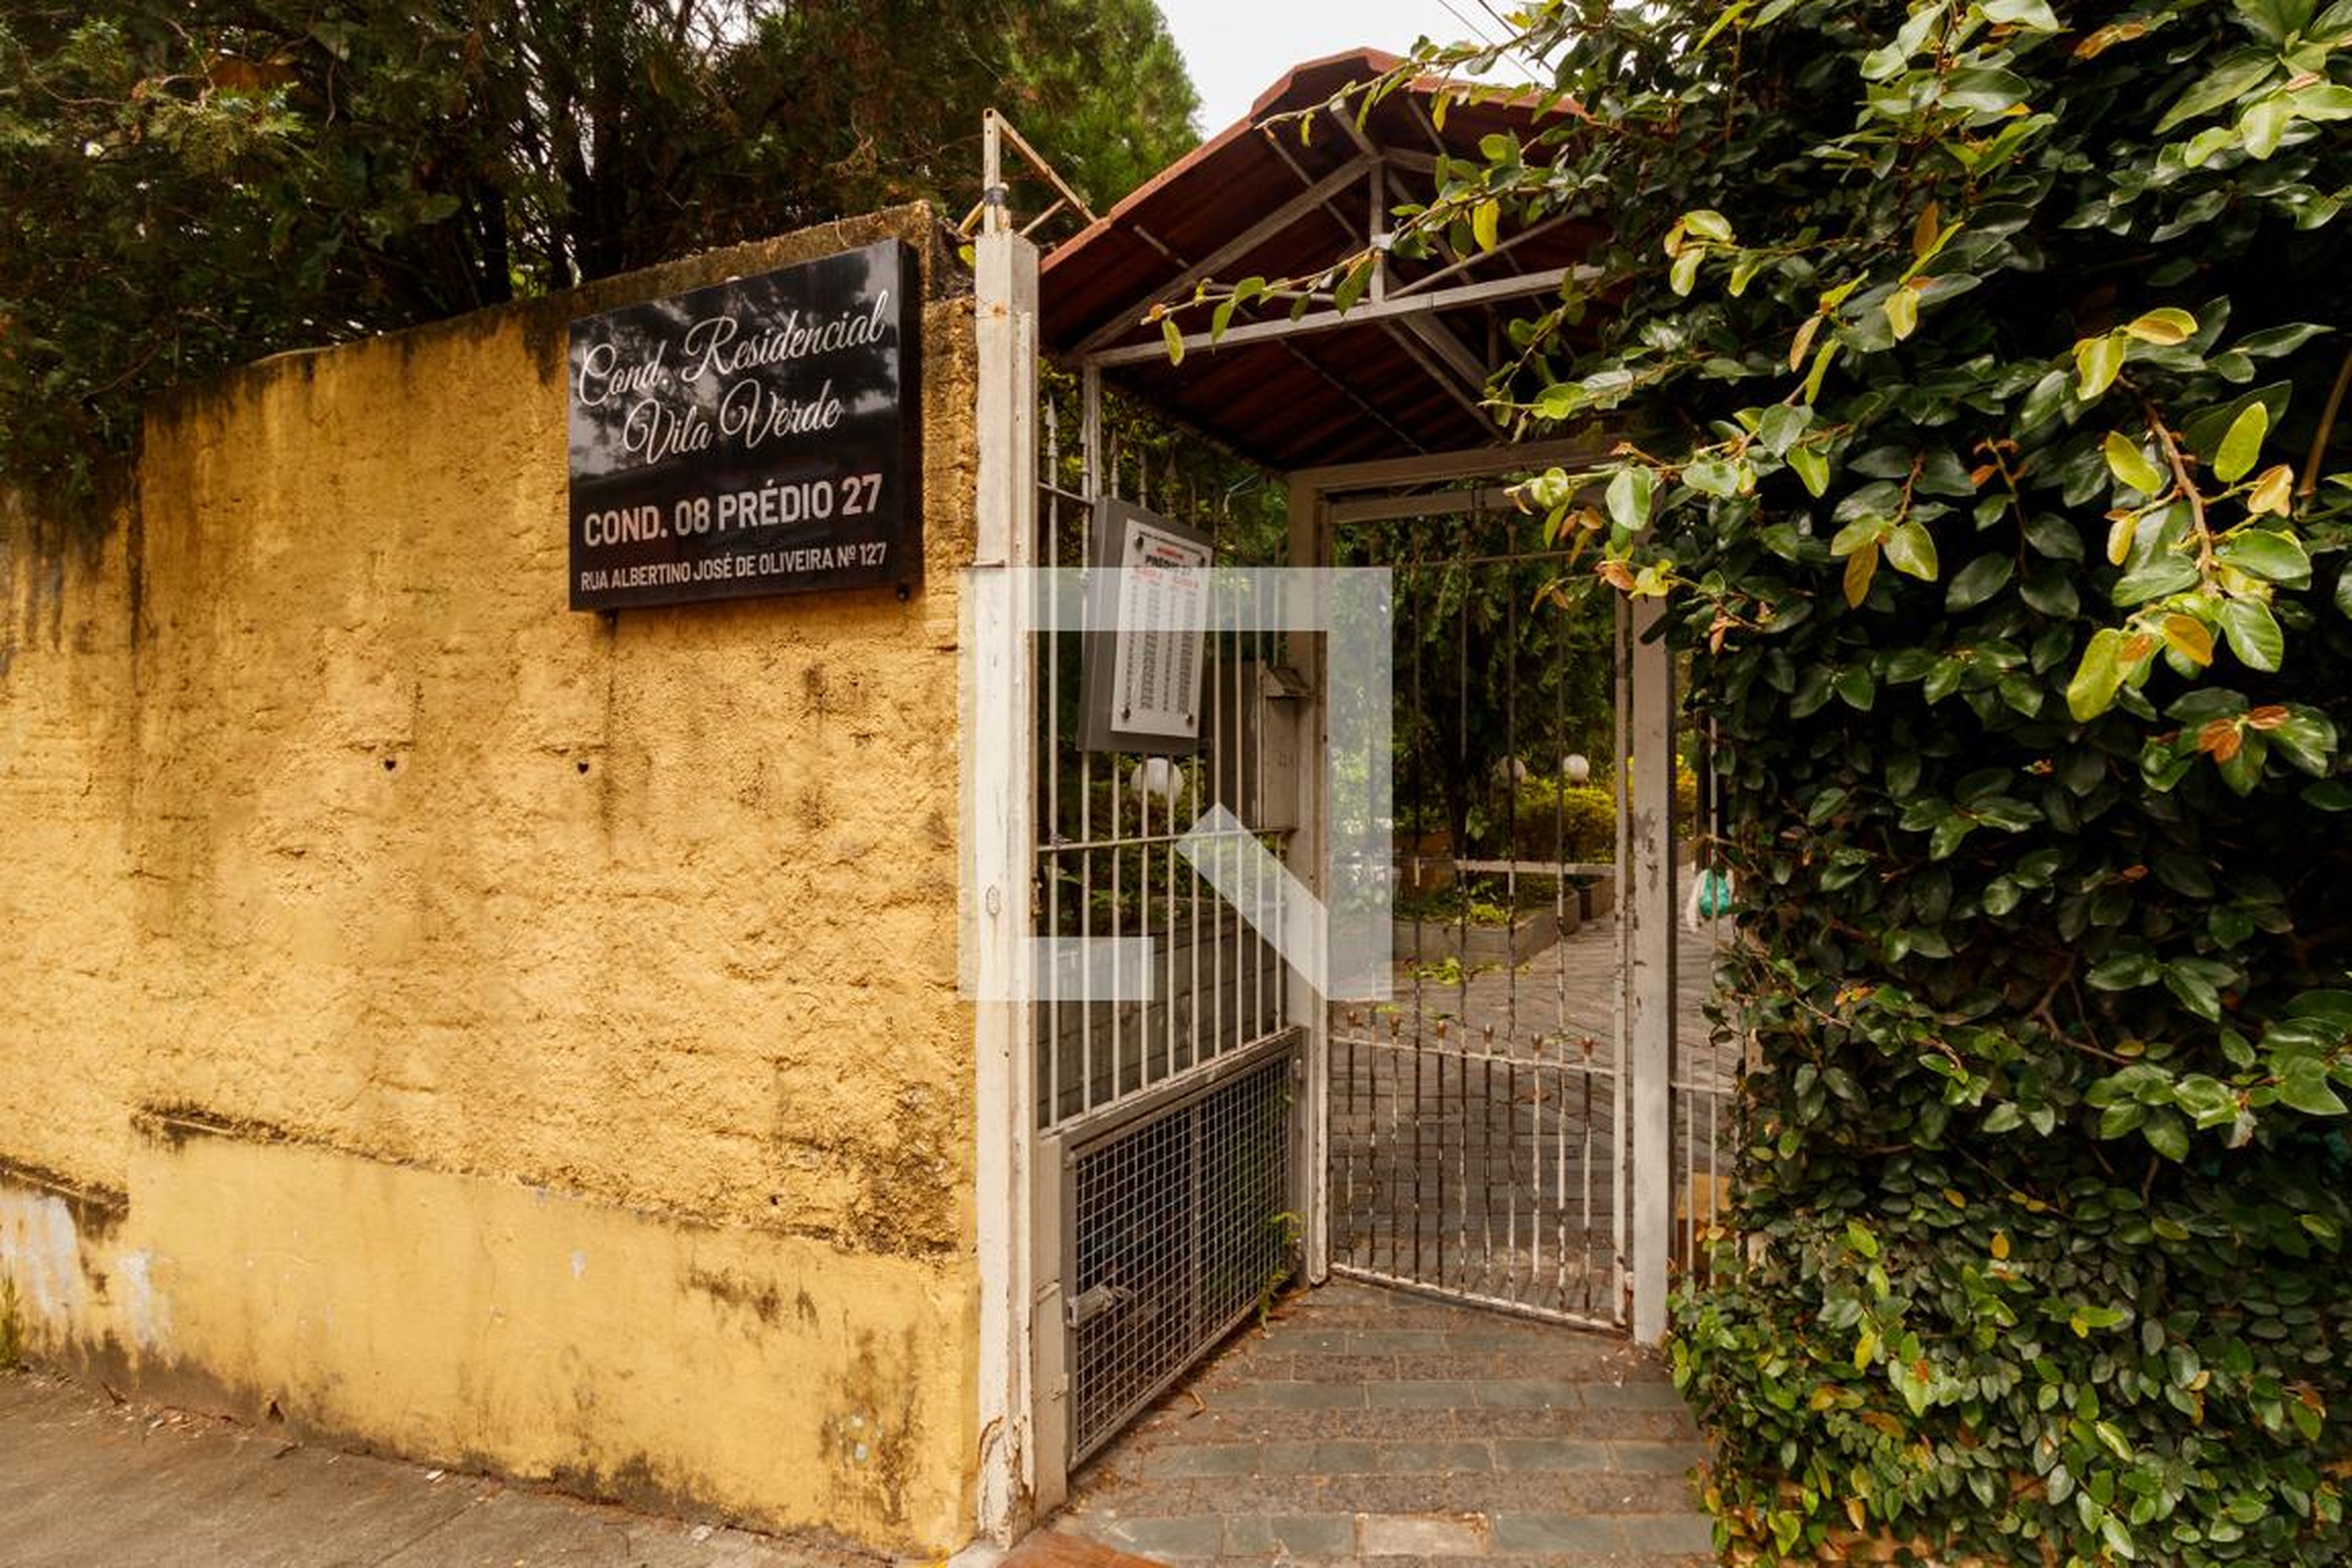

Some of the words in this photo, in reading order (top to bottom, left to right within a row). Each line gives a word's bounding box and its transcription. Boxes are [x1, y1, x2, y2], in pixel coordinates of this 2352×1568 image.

[579, 335, 668, 406] Cond.
[681, 289, 889, 382] Residencial
[623, 398, 713, 464] Vila
[720, 378, 844, 449] Verde
[584, 505, 668, 547] COND.
[674, 497, 711, 536] 08
[718, 478, 834, 532] PRÉDIO
[842, 473, 883, 515] 27
[581, 570, 608, 592] RUA
[611, 562, 692, 589] ALBERTINO
[693, 552, 733, 581] JOSÉ
[736, 556, 756, 578] DE
[759, 548, 834, 576] OLIVEIRA
[859, 541, 887, 566] 127
